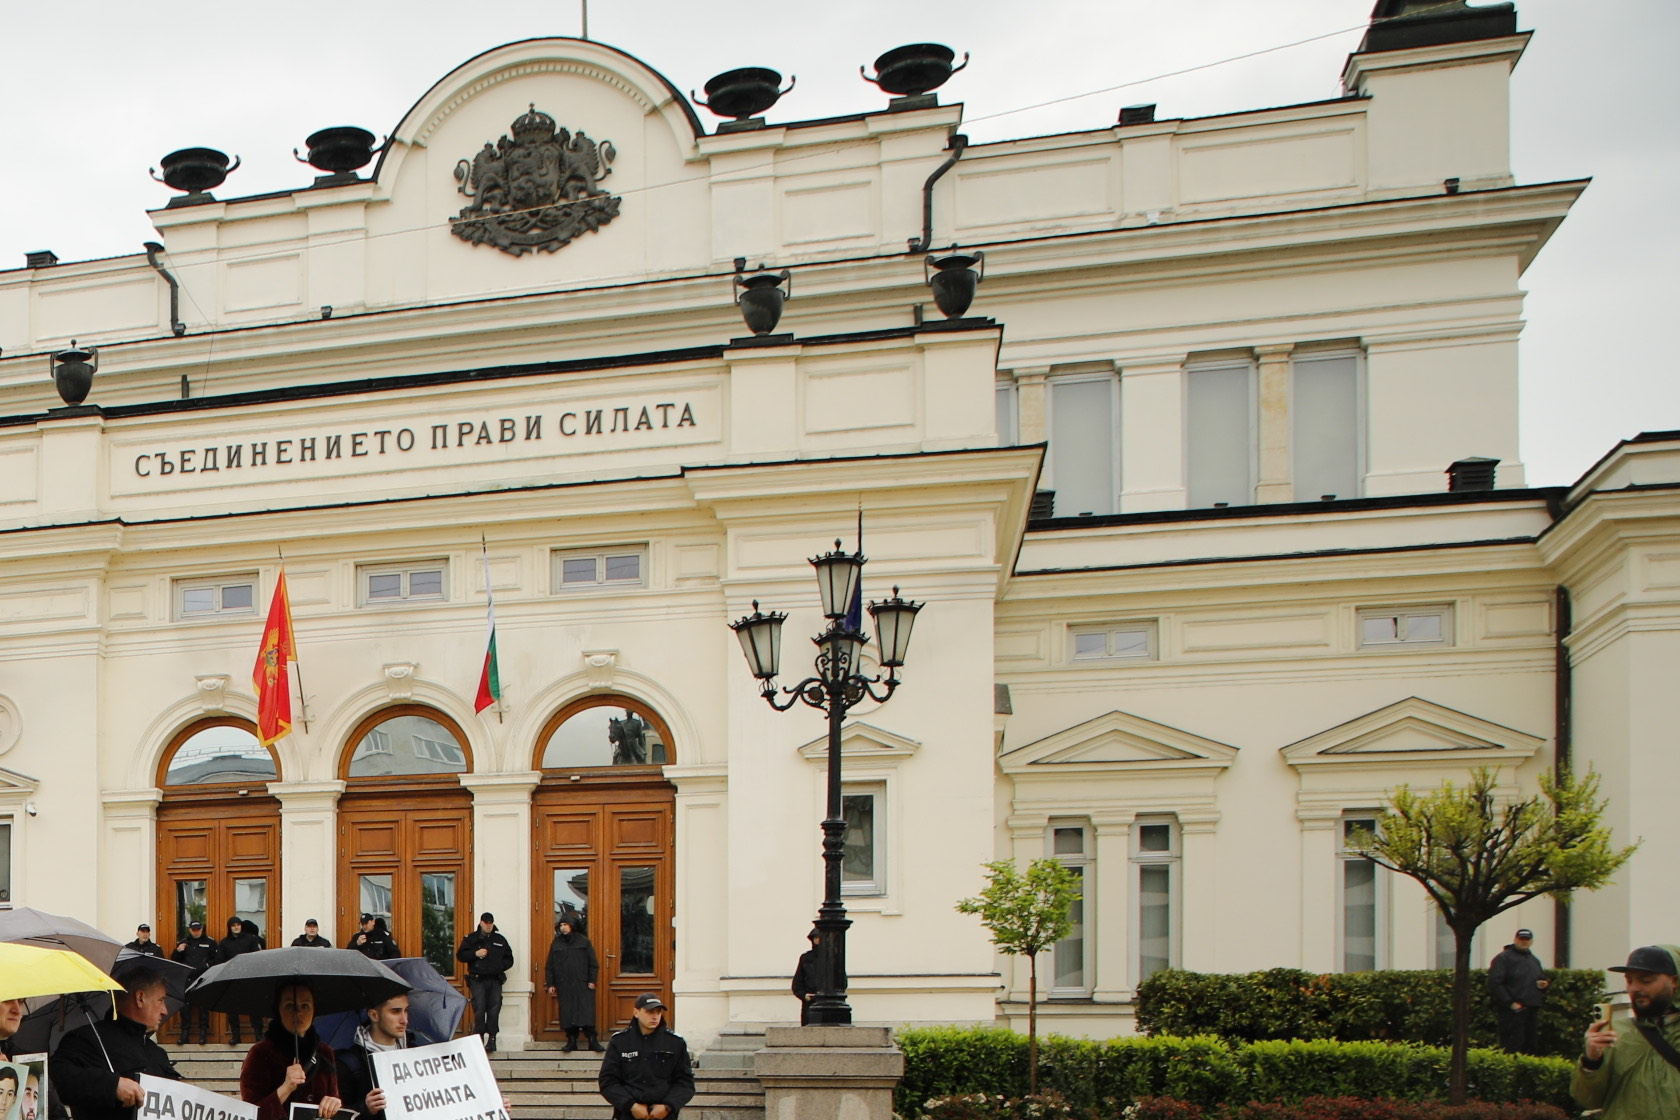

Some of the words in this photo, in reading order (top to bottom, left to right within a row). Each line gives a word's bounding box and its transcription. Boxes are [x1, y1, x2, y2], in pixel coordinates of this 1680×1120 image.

[134, 428, 415, 477] СЪЕДИНЕНИЕТО
[430, 415, 542, 450] ПРАВИ
[559, 402, 697, 436] СИЛАТА
[392, 1062, 413, 1084] ДА
[413, 1052, 467, 1077] СПРЕМ
[143, 1090, 176, 1120] ДА
[402, 1084, 476, 1113] ВОЙНАТА
